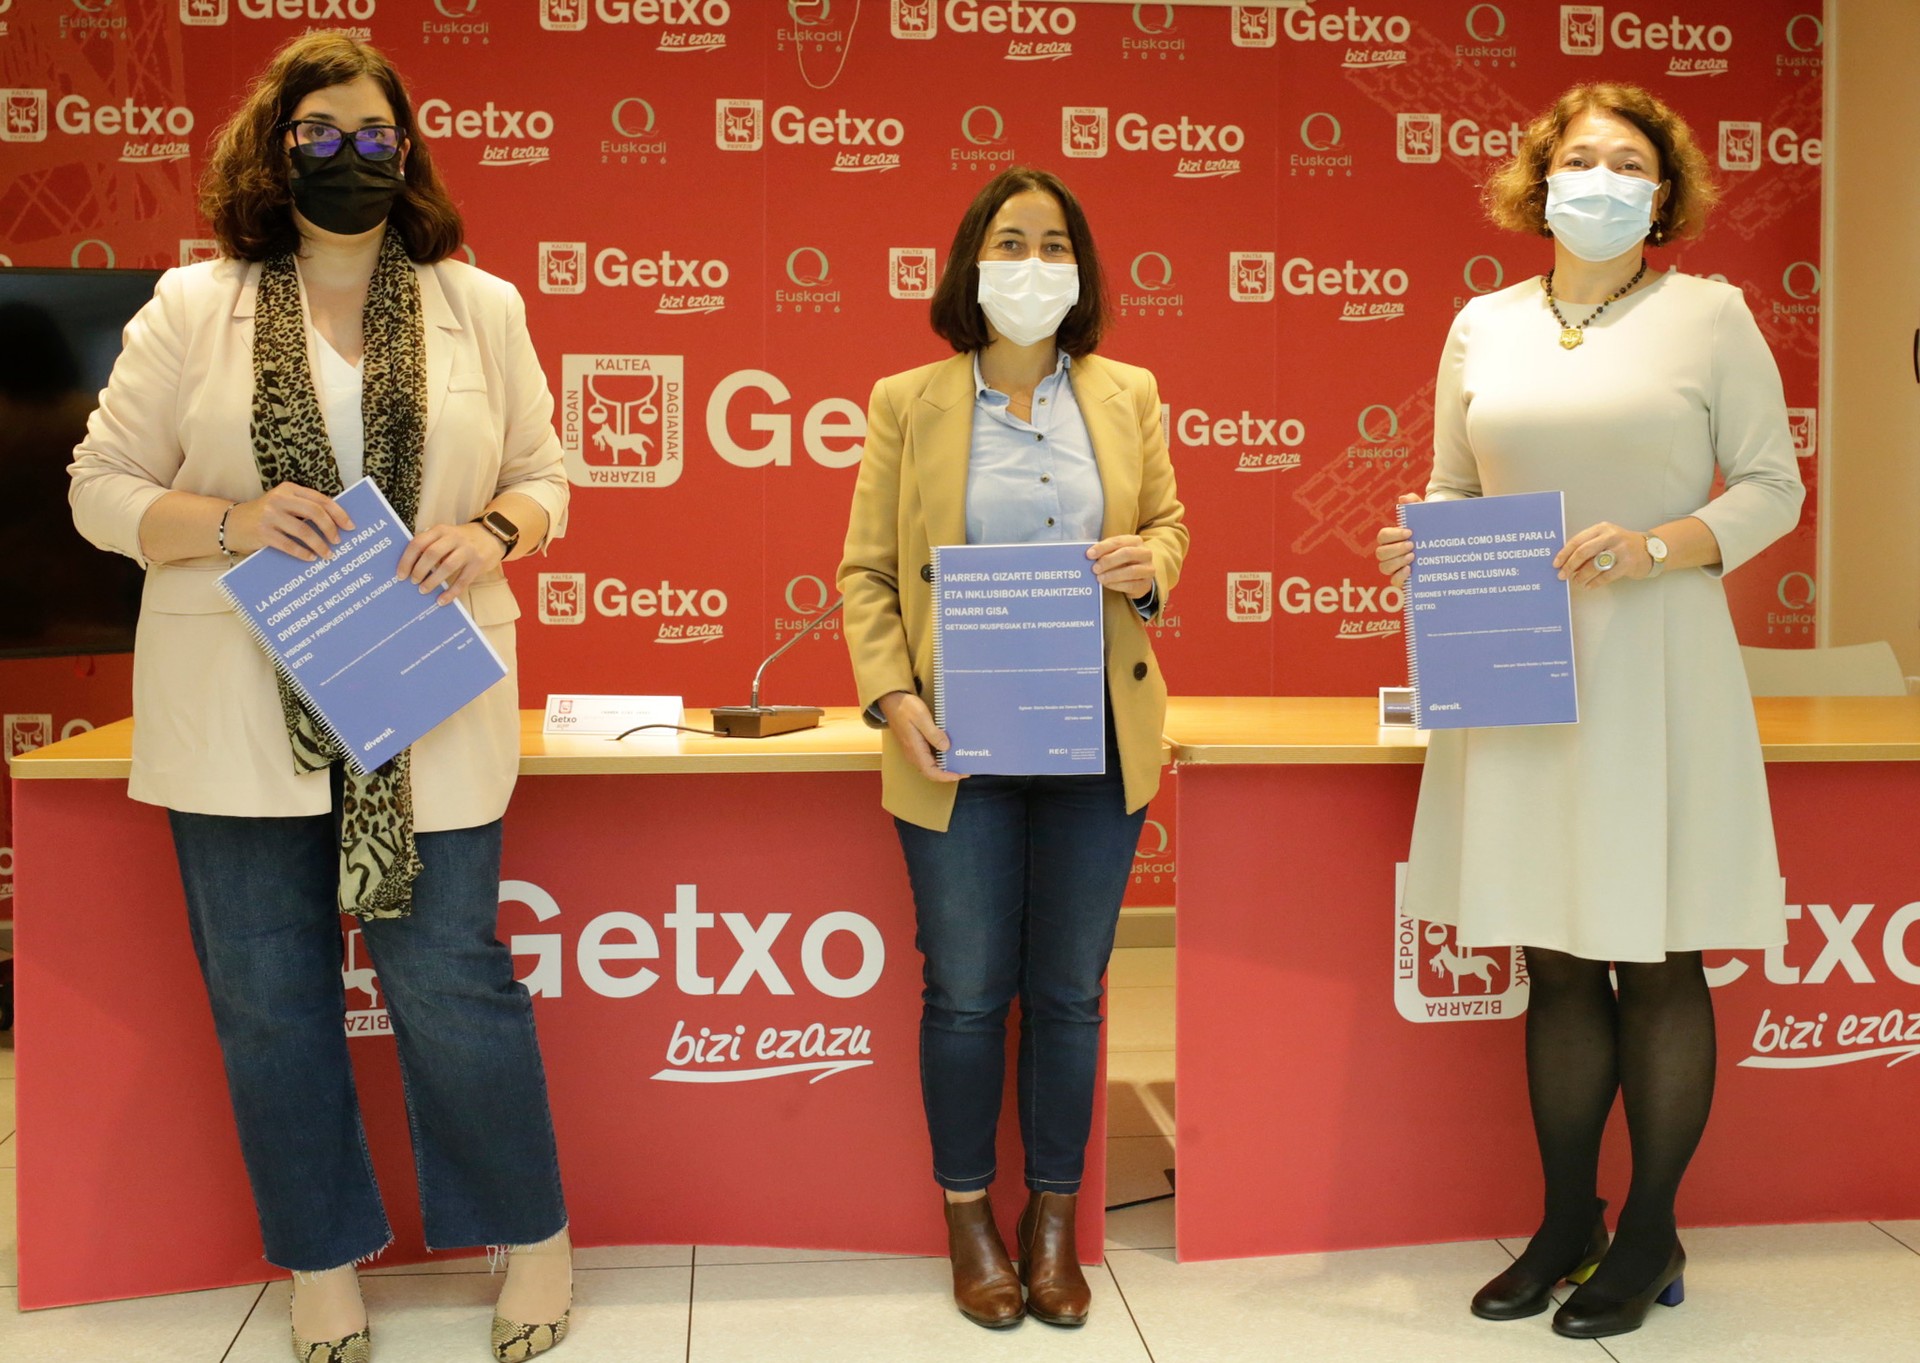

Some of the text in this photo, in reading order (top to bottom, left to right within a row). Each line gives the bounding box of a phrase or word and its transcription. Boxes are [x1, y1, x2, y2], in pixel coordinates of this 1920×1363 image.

[595, 0, 731, 26] Getxo
[945, 0, 1077, 35] Getxo
[60, 15, 128, 28] Euskadi
[423, 21, 489, 34] Euskadi
[1283, 6, 1411, 43] Getxo
[1466, 3, 1506, 42] Q
[661, 31, 726, 46] bizi ezazu
[777, 28, 842, 41] Euskadi
[1611, 12, 1733, 52] Getxo
[1009, 41, 1072, 56] bizi ezazu
[1122, 37, 1185, 50] Euskadi
[1344, 48, 1407, 63] bizi ezazu
[1454, 45, 1516, 58] Euskadi
[1670, 57, 1728, 71] bizi ezazu
[1776, 54, 1822, 67] Euska
[1776, 68, 1818, 76] 200
[56, 95, 194, 136] Getxo
[418, 99, 554, 139] Getxo
[611, 97, 658, 138] Q
[771, 106, 904, 146] Getxo
[961, 105, 1008, 145] Q
[1116, 113, 1244, 152] Getxo
[1300, 112, 1344, 151] Q
[1448, 119, 1523, 157] Get
[123, 142, 190, 157] bizi ezazu
[483, 145, 550, 160] bizi ezazu
[601, 141, 666, 153] Euskadi
[951, 148, 1015, 160] Euskadi
[837, 152, 900, 167] bizi ezazu
[1178, 158, 1240, 172] bizi ezazu
[1290, 154, 1352, 167] Euskadi
[594, 248, 729, 288] Getxo
[786, 247, 832, 287] Q
[1130, 251, 1175, 291] Q
[1282, 257, 1409, 295] Getxo
[660, 294, 725, 308] bizi ezazu
[776, 290, 840, 302] Euskadi
[1120, 294, 1183, 306] Euskadi
[1343, 301, 1404, 316] bizi ezazu
[1773, 302, 1819, 314] Euska
[1773, 315, 1814, 324] 200
[595, 358, 651, 371] KALTEA
[566, 389, 579, 450] LEPOAN
[666, 381, 679, 461] DAGIANAK
[1357, 404, 1402, 443] Q
[1177, 409, 1304, 446] Getxo
[1239, 452, 1301, 467] bizi ezazu
[1347, 446, 1409, 458] Euskadi
[589, 470, 656, 483] BIZARRA
[1415, 530, 1556, 549] LA ACOGIDA COMO BASE PARA LA
[1417, 548, 1551, 566] CONSTRUCCIÓN DE SOCIEDADES
[255, 600, 270, 612] LA
[268, 575, 306, 604] ACOGIDA
[304, 558, 331, 578] COMO
[351, 527, 376, 546] PARA
[374, 519, 388, 531] LA
[267, 536, 392, 626] CONSTRUCCIÓN DE SOCIEDADES
[944, 570, 1081, 582] HARRERA GIZARTE DIBERTSO
[1418, 567, 1520, 583] DIVERSAS E INCLUSIVAS:
[594, 578, 728, 616] Getxo
[784, 575, 830, 614] Q
[944, 587, 1092, 599] ETA INKLUSIBOAK ERAIKITZEKO
[1279, 576, 1404, 614] Getxo
[1448, 587, 1488, 596] PROPUESTAS
[277, 573, 374, 642] DIVERSAS E INCLUSIVAS:
[945, 607, 1009, 616] OINARRI GISA
[283, 637, 312, 659] VISIONES
[315, 607, 355, 637] PROPUESTAS
[353, 601, 364, 611] DE
[361, 596, 371, 605] LA
[370, 580, 393, 599] CIUDAD
[1037, 620, 1095, 629] PROPOSAMENAK
[1768, 612, 1816, 624] Euska
[659, 623, 724, 638] bizi ezazu
[1340, 619, 1401, 634] bizi ezazu
[1768, 626, 1808, 634] 200
[551, 715, 577, 723] Getxo
[498, 880, 885, 998] Getxo
[1400, 914, 1414, 979] LEPOA
[1426, 1000, 1502, 1017] BIZARRA
[345, 1014, 389, 1031] BIZA
[1752, 1009, 1920, 1053] bizi ezaz
[666, 1020, 871, 1066] bizi ezazu
